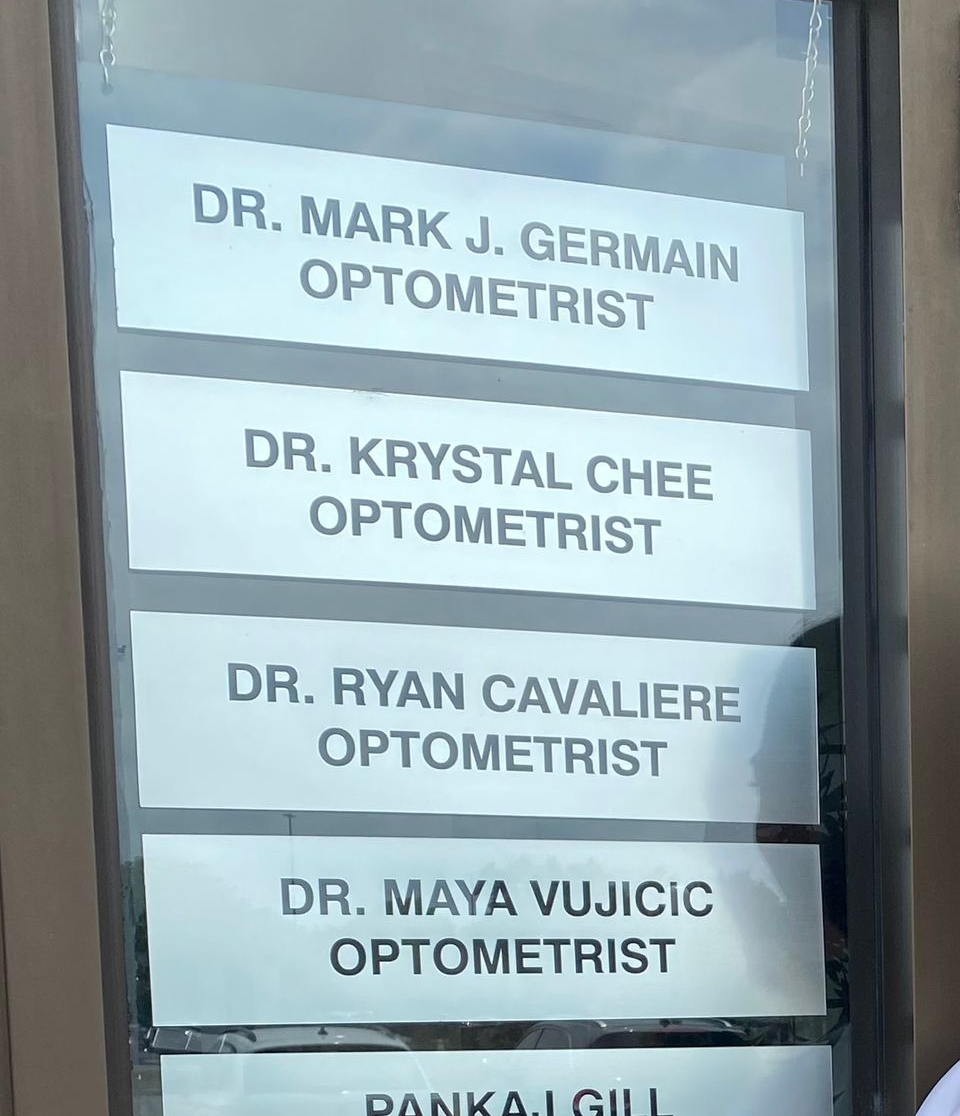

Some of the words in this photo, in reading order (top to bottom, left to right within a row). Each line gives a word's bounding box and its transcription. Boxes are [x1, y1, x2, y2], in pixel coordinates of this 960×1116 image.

[193, 183, 281, 231] DR.
[301, 196, 451, 249] MARK
[466, 216, 503, 255] J.
[517, 222, 738, 282] GERMAIN
[300, 258, 654, 330] OPTOMETRIST
[245, 429, 331, 472] DR.
[350, 437, 572, 490] KRYSTAL
[587, 456, 713, 501] CHEE
[310, 496, 661, 555] OPTOMETRIST
[228, 663, 314, 704] DR.
[334, 668, 464, 710] RYAN
[483, 674, 742, 723] CAVALIERE
[319, 728, 667, 776] OPTOMETRIST
[281, 878, 365, 915] DR.
[385, 880, 517, 916] MAYA
[331, 938, 675, 976] OPTOMETRIST
